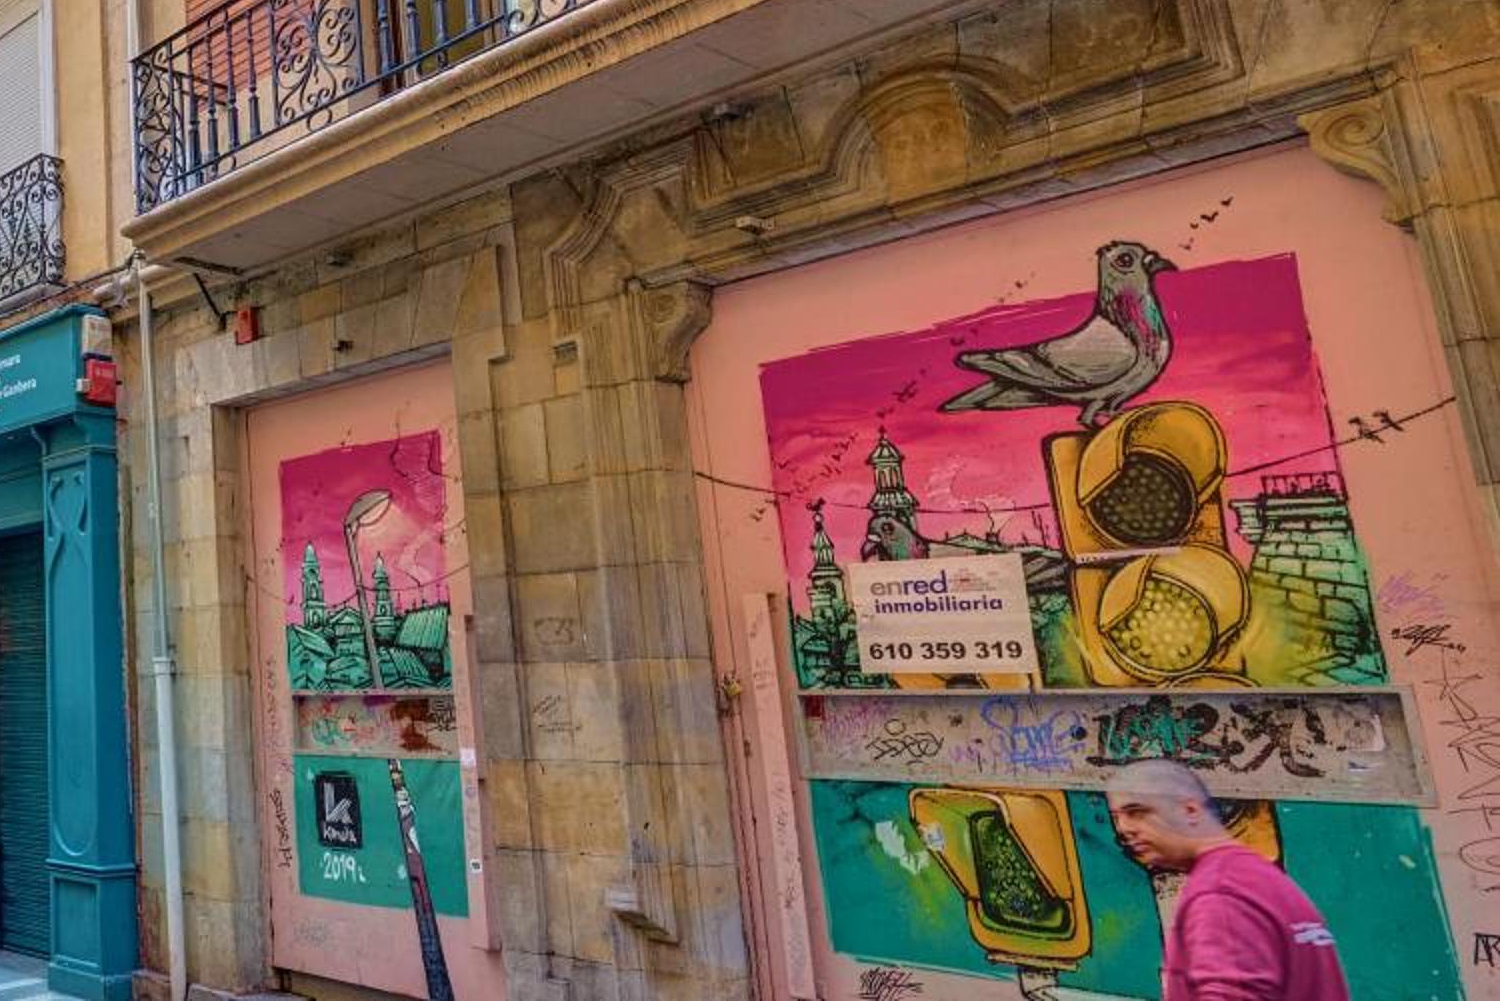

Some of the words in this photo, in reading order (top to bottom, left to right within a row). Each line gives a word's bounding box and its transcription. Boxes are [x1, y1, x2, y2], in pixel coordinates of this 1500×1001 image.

[870, 570, 949, 596] enred
[875, 597, 1003, 614] inmobiliaria
[869, 642, 913, 660] 610
[921, 642, 966, 660] 359
[975, 640, 1023, 659] 319
[323, 852, 357, 883] 2019
